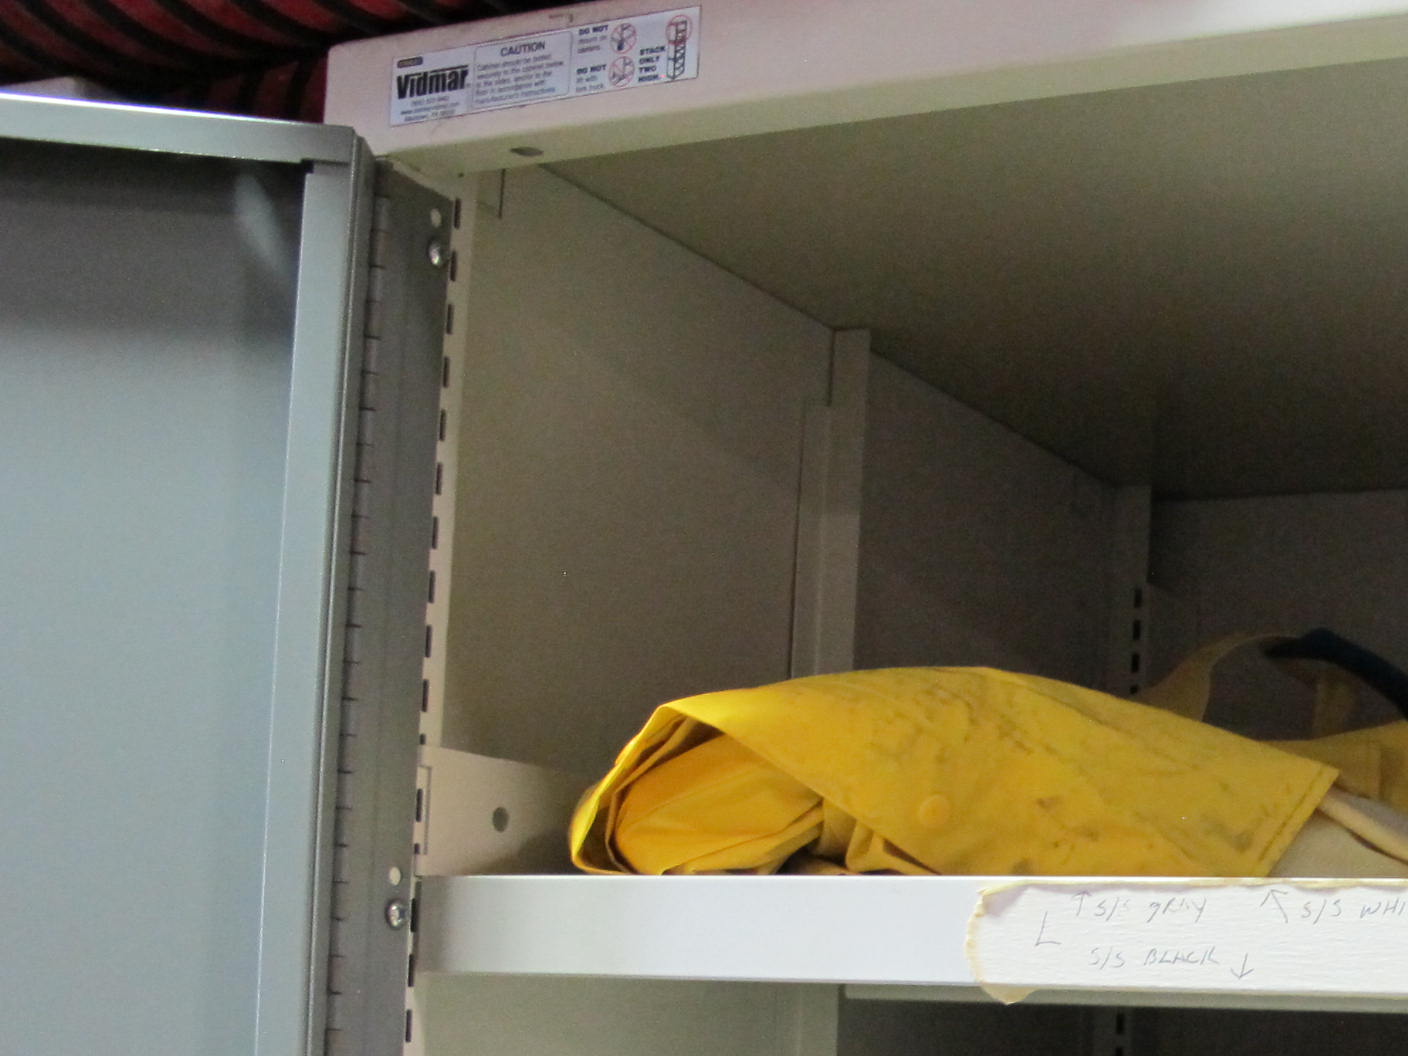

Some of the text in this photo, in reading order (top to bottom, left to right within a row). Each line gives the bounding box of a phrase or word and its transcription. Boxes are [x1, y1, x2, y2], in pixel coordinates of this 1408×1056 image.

[500, 40, 545, 57] CAUTION
[397, 65, 469, 99] Vidmar
[1301, 899, 1342, 925] S/S
[1089, 945, 1220, 970] S/S BLACK
